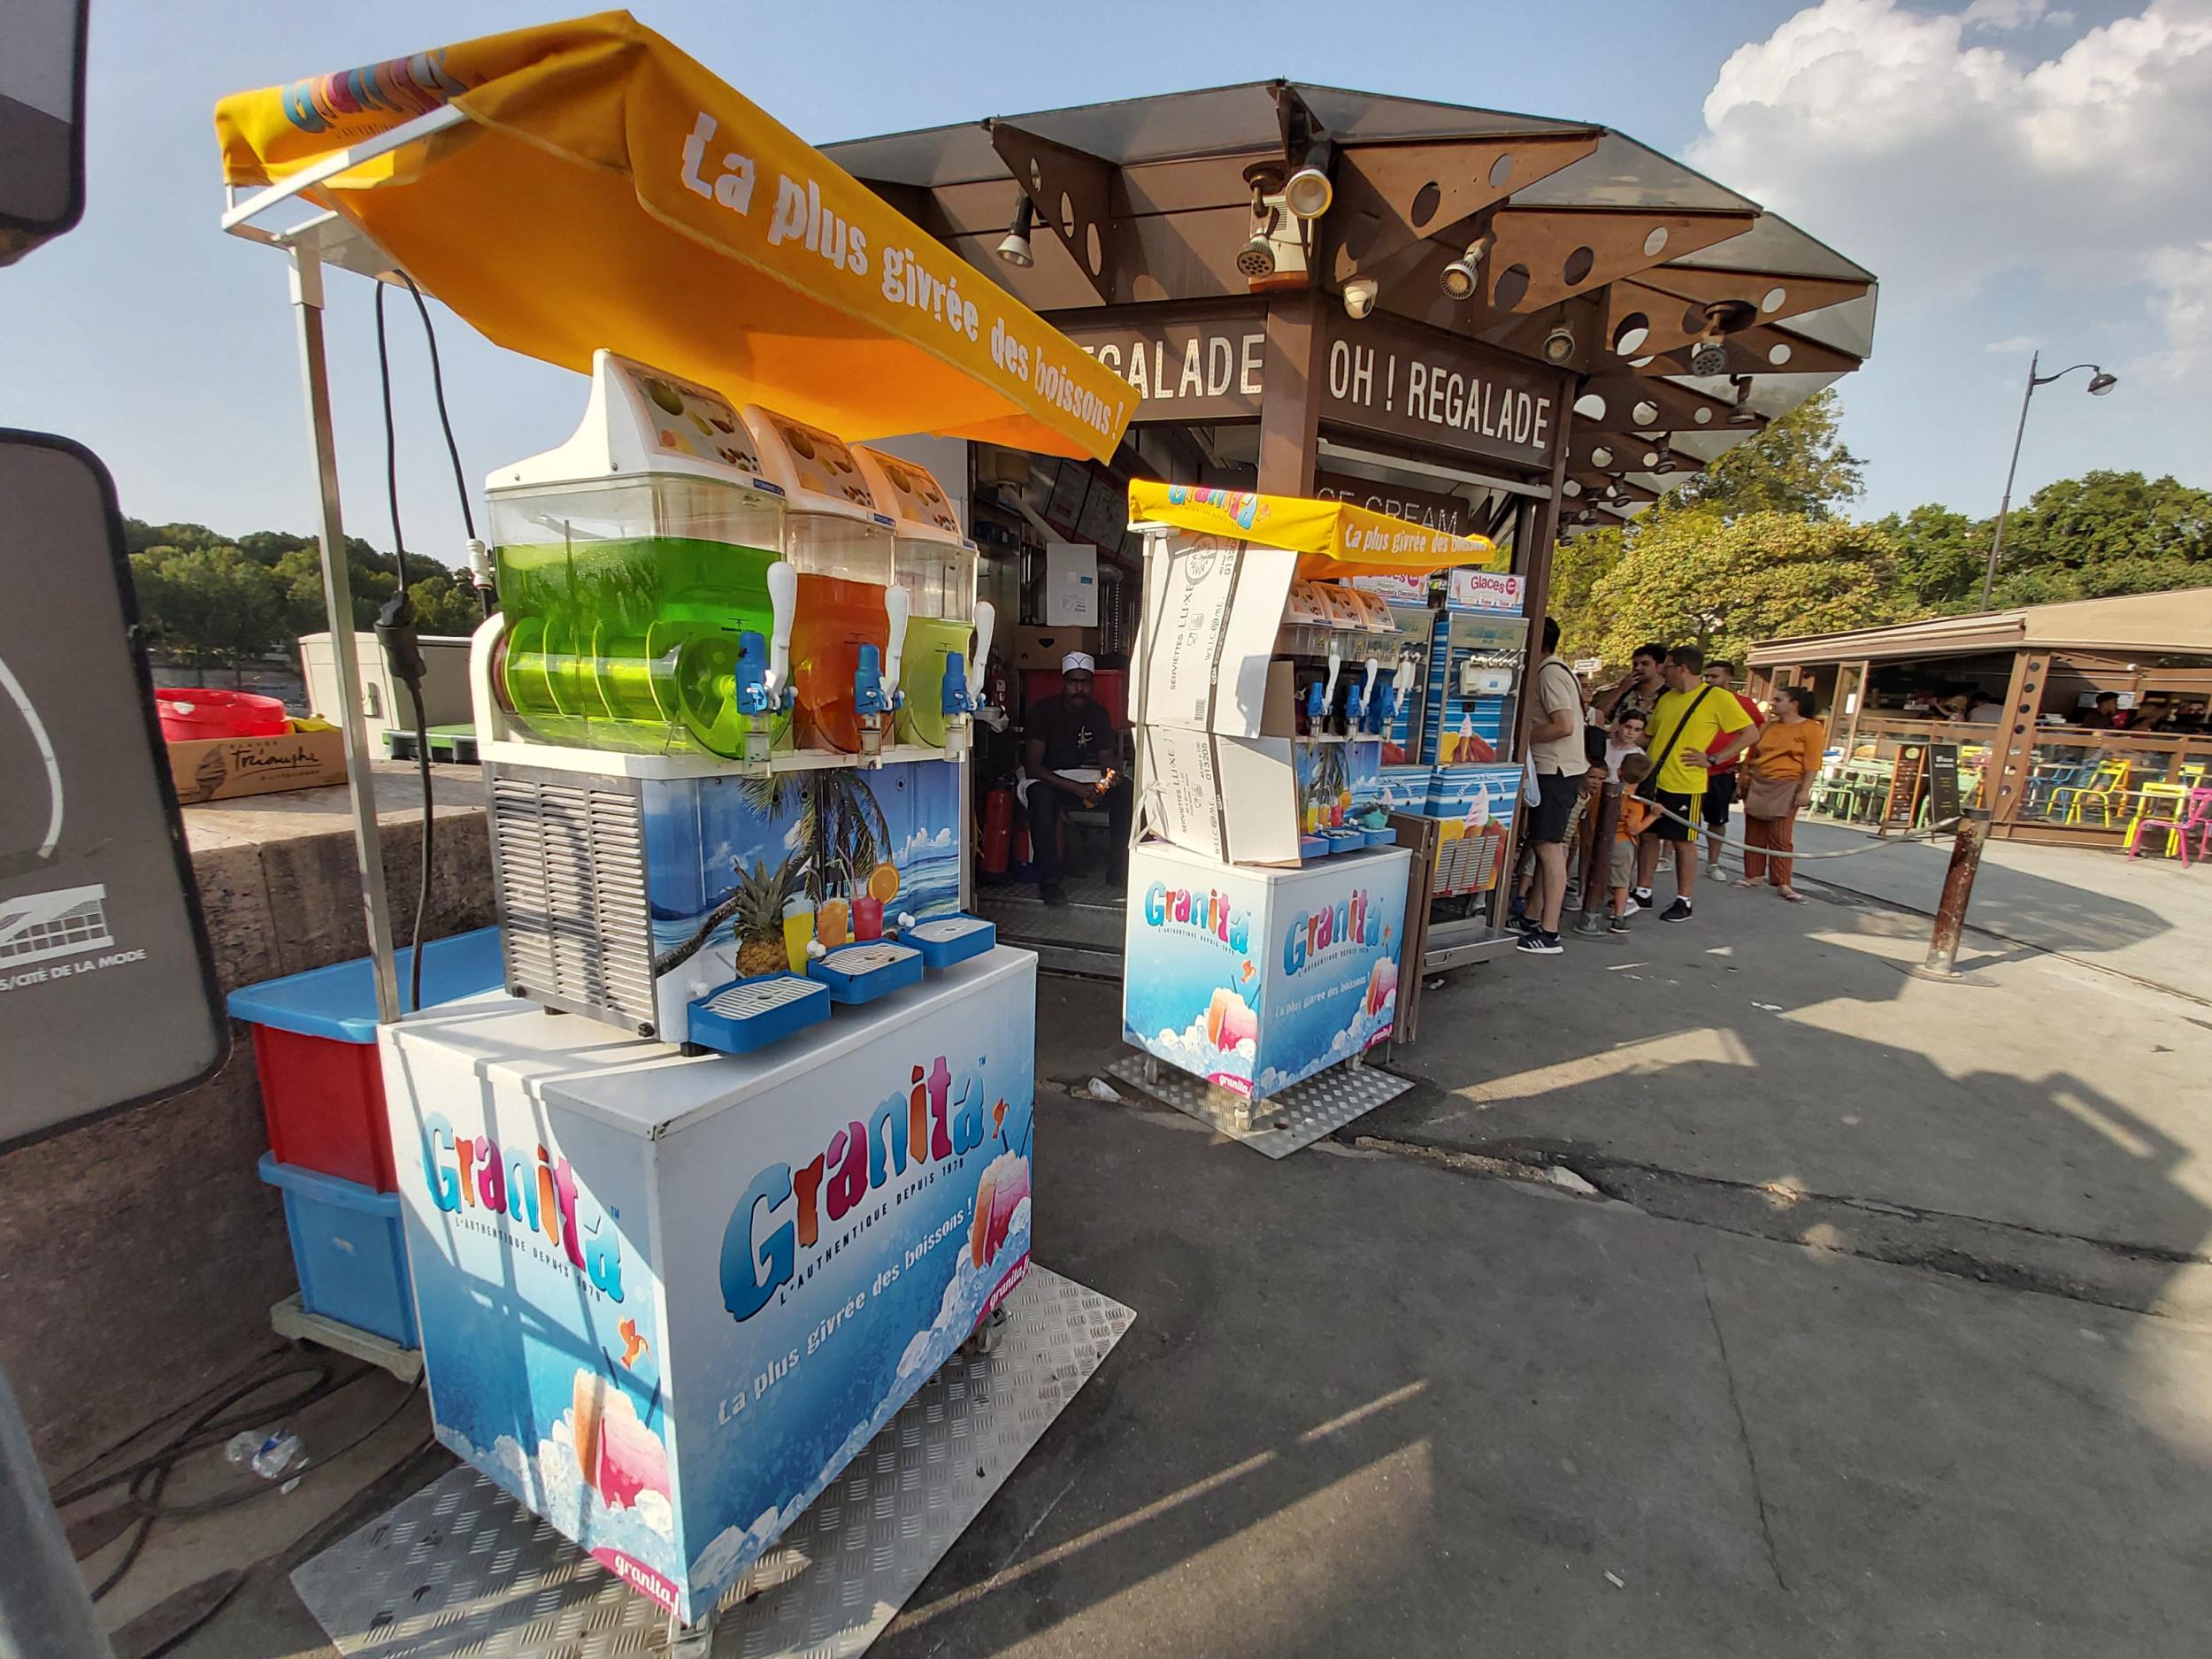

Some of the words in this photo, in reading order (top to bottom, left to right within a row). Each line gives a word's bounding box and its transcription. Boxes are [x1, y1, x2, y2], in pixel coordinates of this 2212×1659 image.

[680, 111, 756, 217] La
[767, 173, 869, 276] plus
[881, 247, 979, 342] givrée
[990, 317, 1029, 382] des
[1034, 346, 1111, 435] boissons
[1329, 339, 1374, 406] OH
[1386, 355, 1395, 411] !
[1407, 361, 1550, 449] REGALADE
[1224, 537, 1238, 575] 01320
[1345, 523, 1362, 549] La
[1363, 526, 1390, 553] plus
[1432, 532, 1448, 553] des
[1471, 576, 1505, 594] Glaces
[1171, 634, 1183, 690] SERVIETTES
[1202, 742, 1212, 780] 013205
[1144, 880, 1249, 955] Granita
[1284, 889, 1380, 976] Granita
[50, 964, 72, 979] DE
[74, 960, 96, 973] LA
[99, 949, 147, 969] MODE
[1327, 987, 1339, 998] des
[422, 1111, 625, 1304] Granita
[719, 1054, 986, 1323] Granita
[456, 1217, 526, 1253] L'AUTHENTIQUE
[533, 1247, 570, 1278] DEPUIS
[780, 1203, 887, 1307] L'AUTHENTIQUE
[896, 1171, 935, 1206] DEPUIS
[718, 1389, 747, 1426] La
[754, 1347, 800, 1401] plus
[806, 1291, 866, 1356] givrée
[872, 1263, 901, 1297] des
[904, 1210, 964, 1271] boissons
